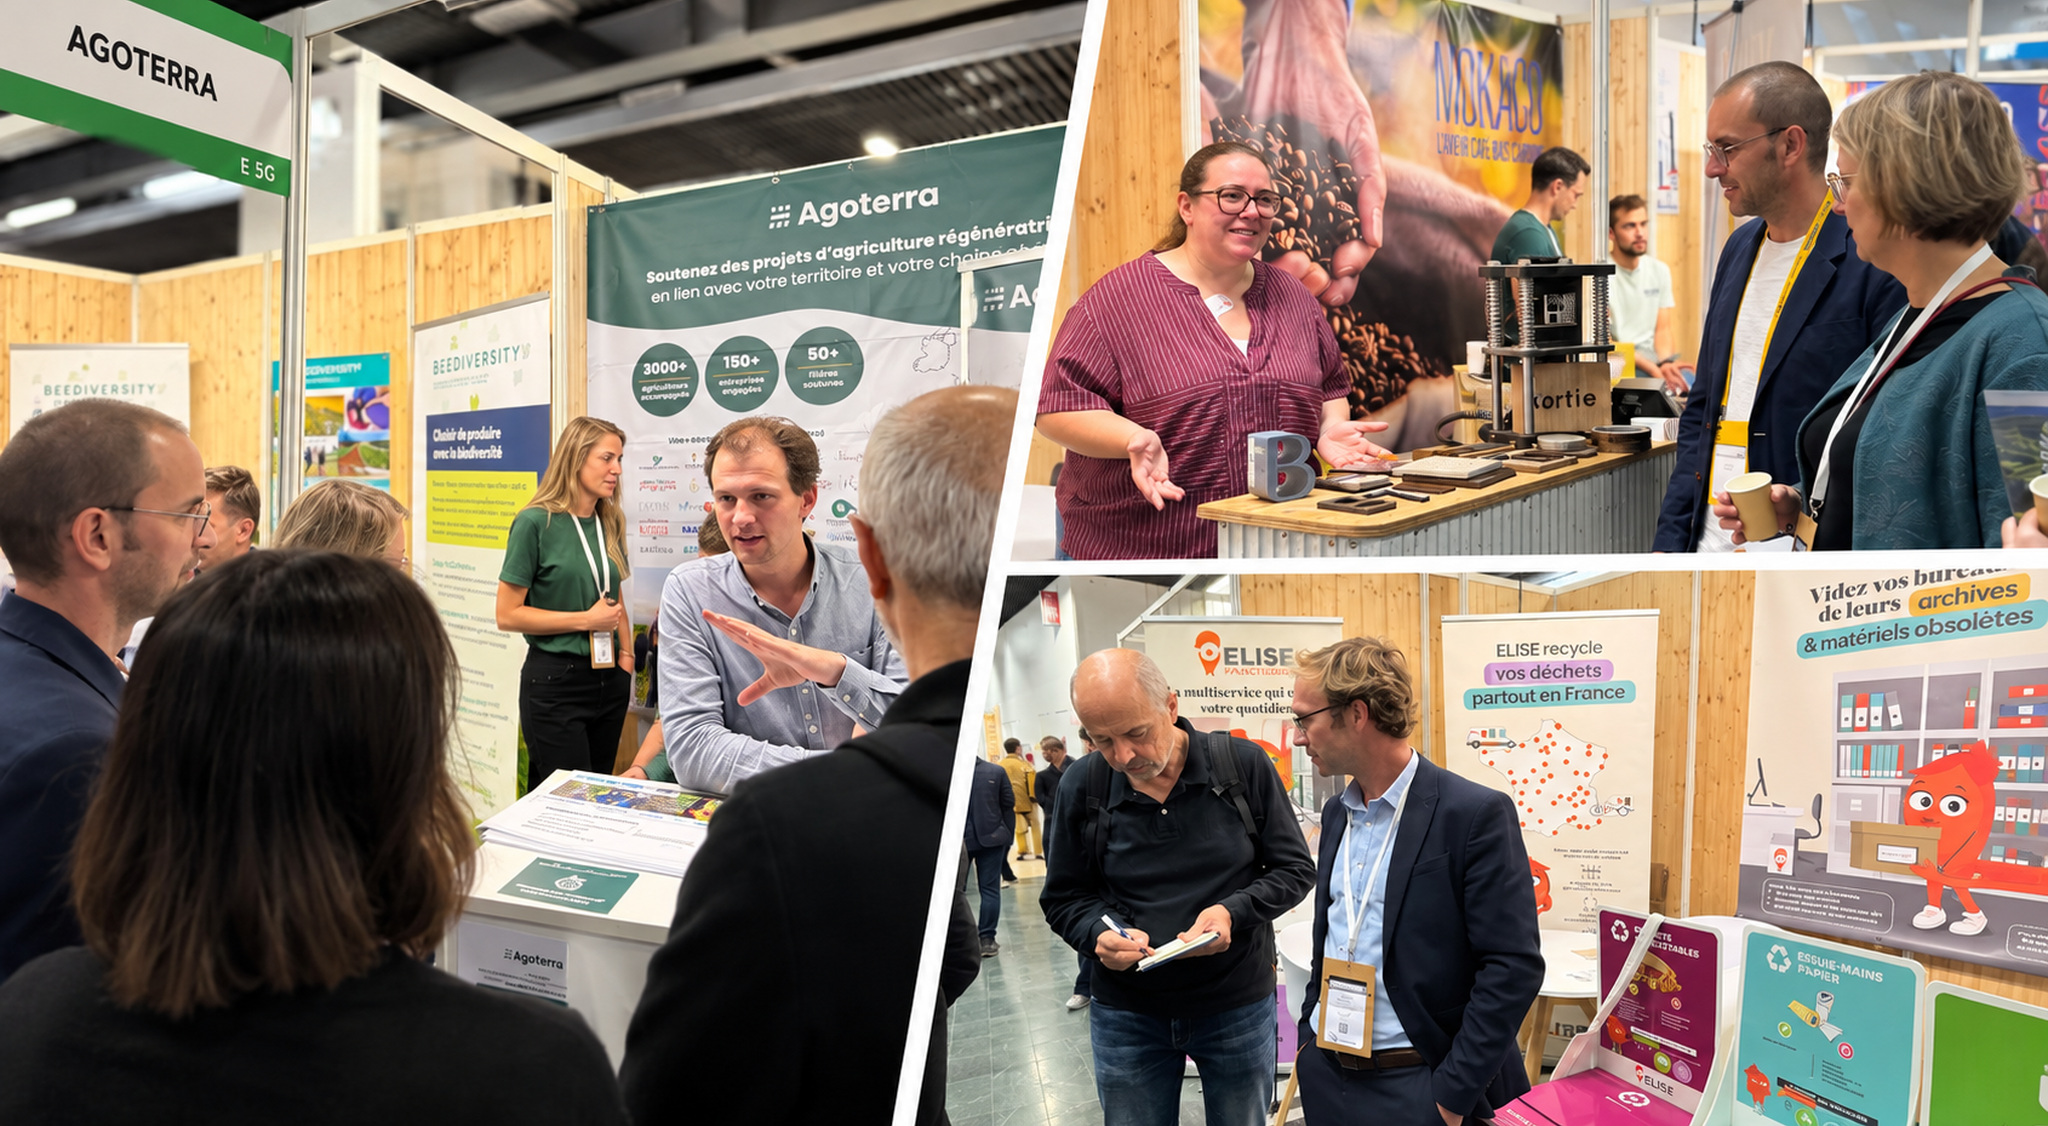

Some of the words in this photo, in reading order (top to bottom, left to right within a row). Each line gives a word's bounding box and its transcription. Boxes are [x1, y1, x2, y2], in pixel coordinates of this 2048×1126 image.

[67, 25, 217, 101] AGOTERRA
[1434, 41, 1542, 135] MOKACO
[241, 157, 249, 175] E
[255, 161, 275, 182] 5G
[798, 187, 939, 228] Agoterra
[646, 264, 718, 284] Soutenez
[720, 260, 750, 275] des
[753, 250, 812, 274] projets
[651, 290, 670, 303] en
[674, 285, 700, 301] lien
[704, 282, 742, 297] avec
[746, 275, 787, 292] votre
[791, 264, 861, 286] territoire
[866, 261, 884, 276] et
[888, 255, 935, 274] votre
[433, 345, 520, 375] BEEDIVERSITY
[723, 354, 760, 369] 150+
[808, 346, 839, 361] 50+
[643, 360, 687, 376] 3000+
[44, 384, 155, 396] BEEDIVERSITY
[1810, 582, 1867, 604] Videz
[1874, 575, 1908, 593] vos
[1819, 605, 1841, 622] de
[1846, 598, 1901, 619] leurs
[1918, 582, 2018, 610] archives
[1804, 637, 1818, 653] &
[1821, 623, 1909, 650] matériels
[1223, 647, 1293, 666] ELISE
[1497, 643, 1540, 657] ELISE
[1543, 641, 1603, 658] recycle
[1496, 668, 1525, 681] vos
[1529, 664, 1602, 680] déchets
[1184, 686, 1263, 698] multiservice
[1264, 687, 1285, 701] qui
[1472, 689, 1537, 709] partout
[1540, 690, 1561, 702] en
[1565, 686, 1625, 701] France
[1201, 705, 1233, 714] votre
[513, 951, 563, 970] Agoterra
[1797, 951, 1883, 983] ESSUIE-MAINS
[1797, 964, 1840, 984] PAPIER
[1644, 1075, 1674, 1096] ELISE
